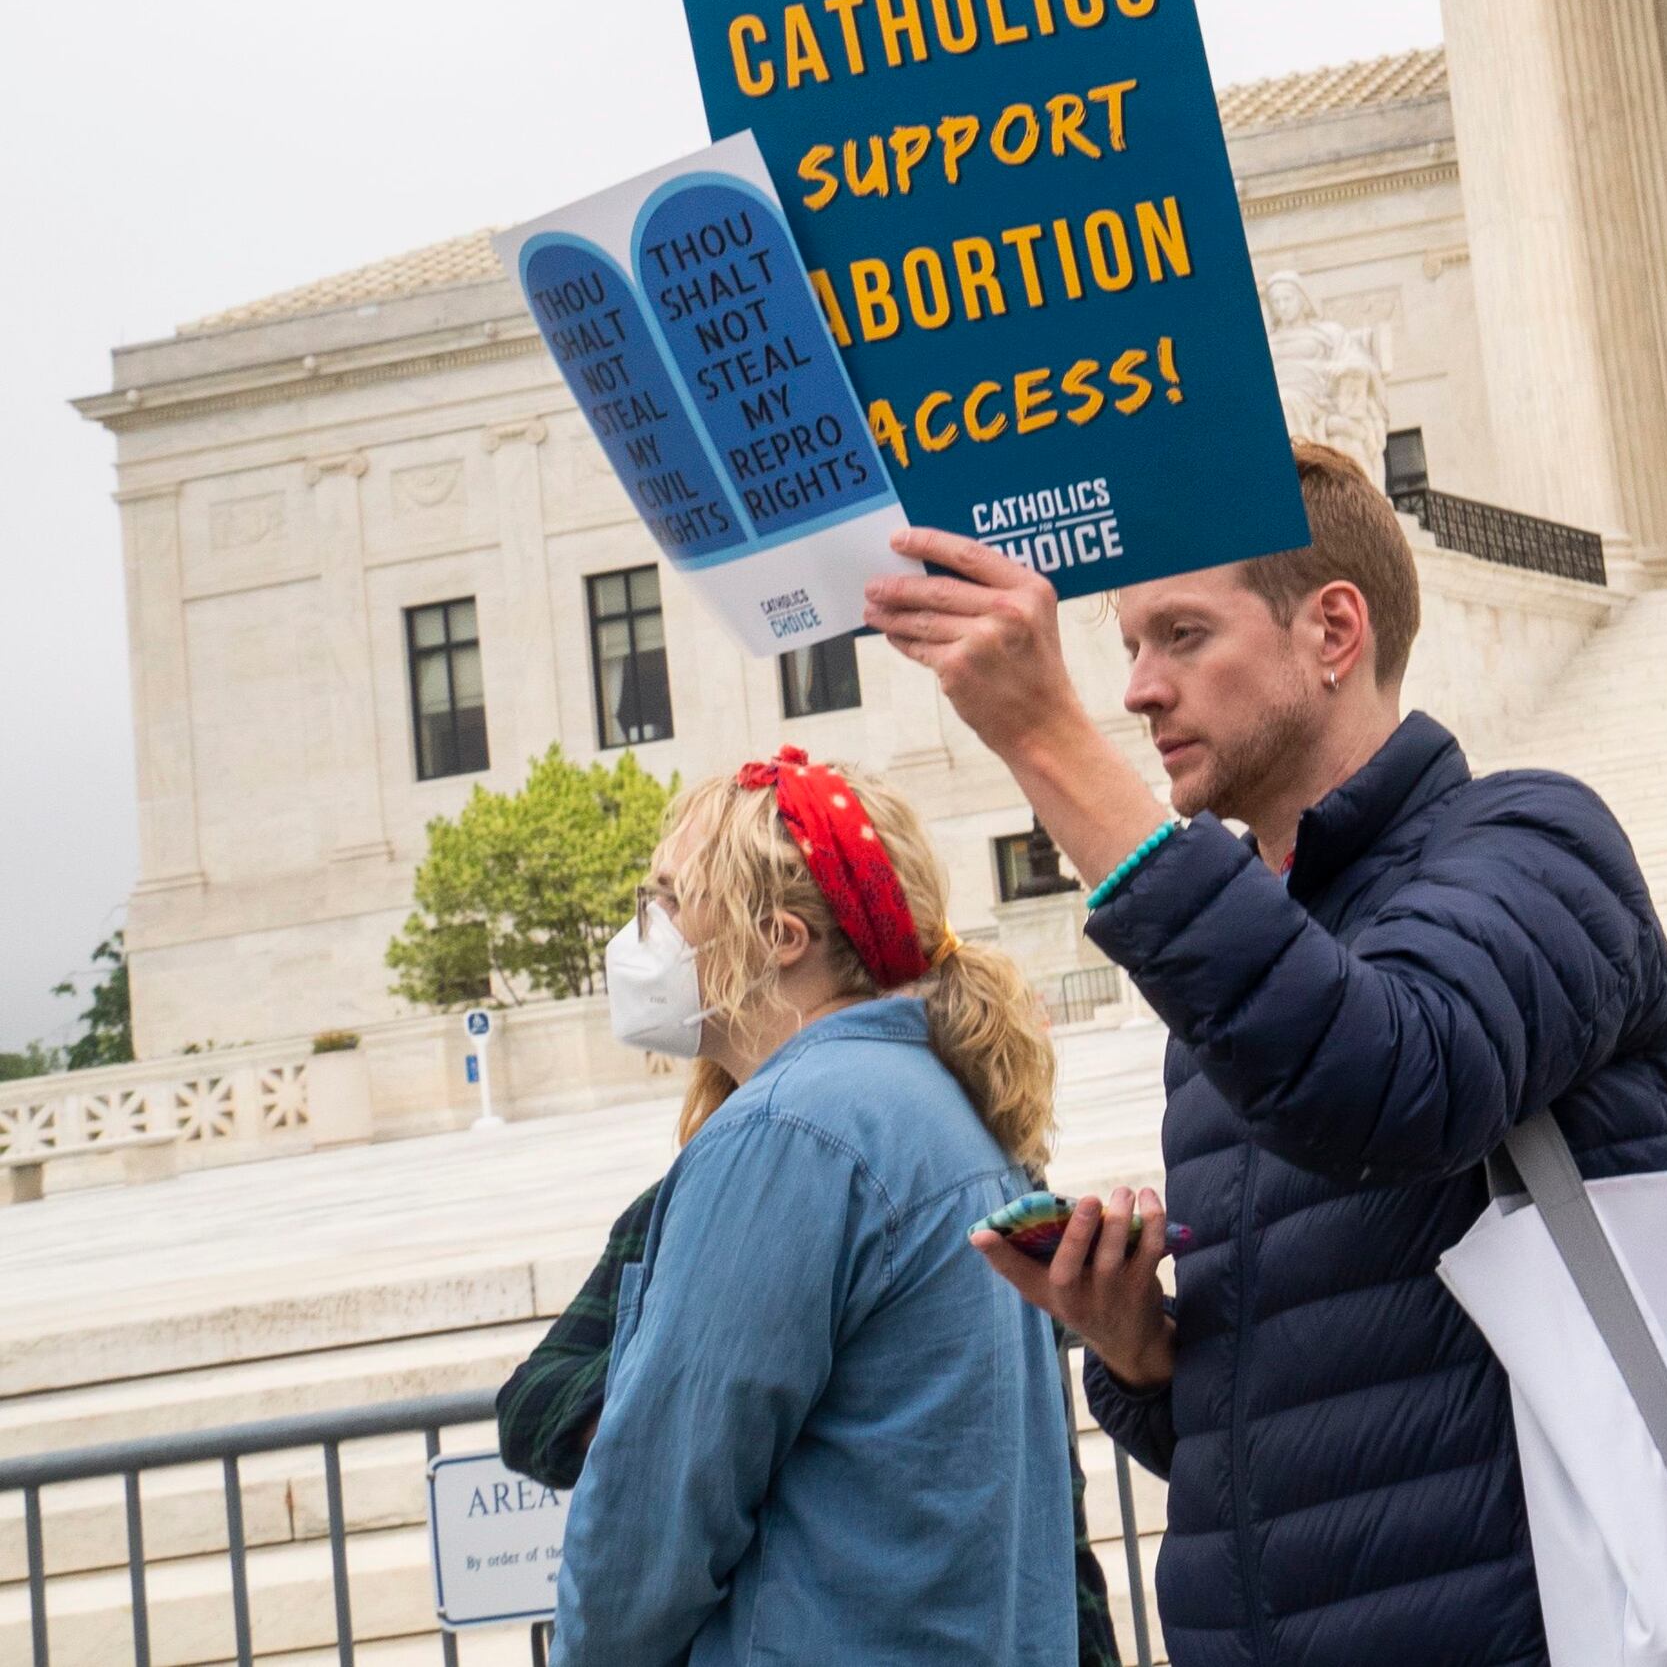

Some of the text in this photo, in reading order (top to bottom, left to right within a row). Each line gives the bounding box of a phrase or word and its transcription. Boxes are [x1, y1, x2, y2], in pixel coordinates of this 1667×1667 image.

[798, 80, 1137, 211] SUPPORT
[647, 211, 753, 277] THOU
[534, 271, 604, 322] THOU
[661, 249, 772, 322] SHALT
[552, 307, 626, 362] SHALT
[694, 297, 768, 354] NOT
[580, 354, 630, 396] NOT
[697, 336, 812, 400] STEAL
[593, 391, 668, 436] STEAL
[740, 383, 790, 430] MY
[868, 337, 1185, 467] ACCESS!
[625, 434, 661, 469] MY
[729, 414, 842, 481] REPRO
[637, 470, 699, 510] CIVIL
[743, 451, 867, 521] RIGHTS
[972, 477, 1112, 534] CATHOLICS
[990, 518, 1124, 573] HOICE
[770, 606, 822, 638] CHOICE
[467, 1479, 561, 1520] AREA
[465, 1555, 481, 1572] By
[487, 1552, 520, 1568] order
[526, 1547, 539, 1563] of
